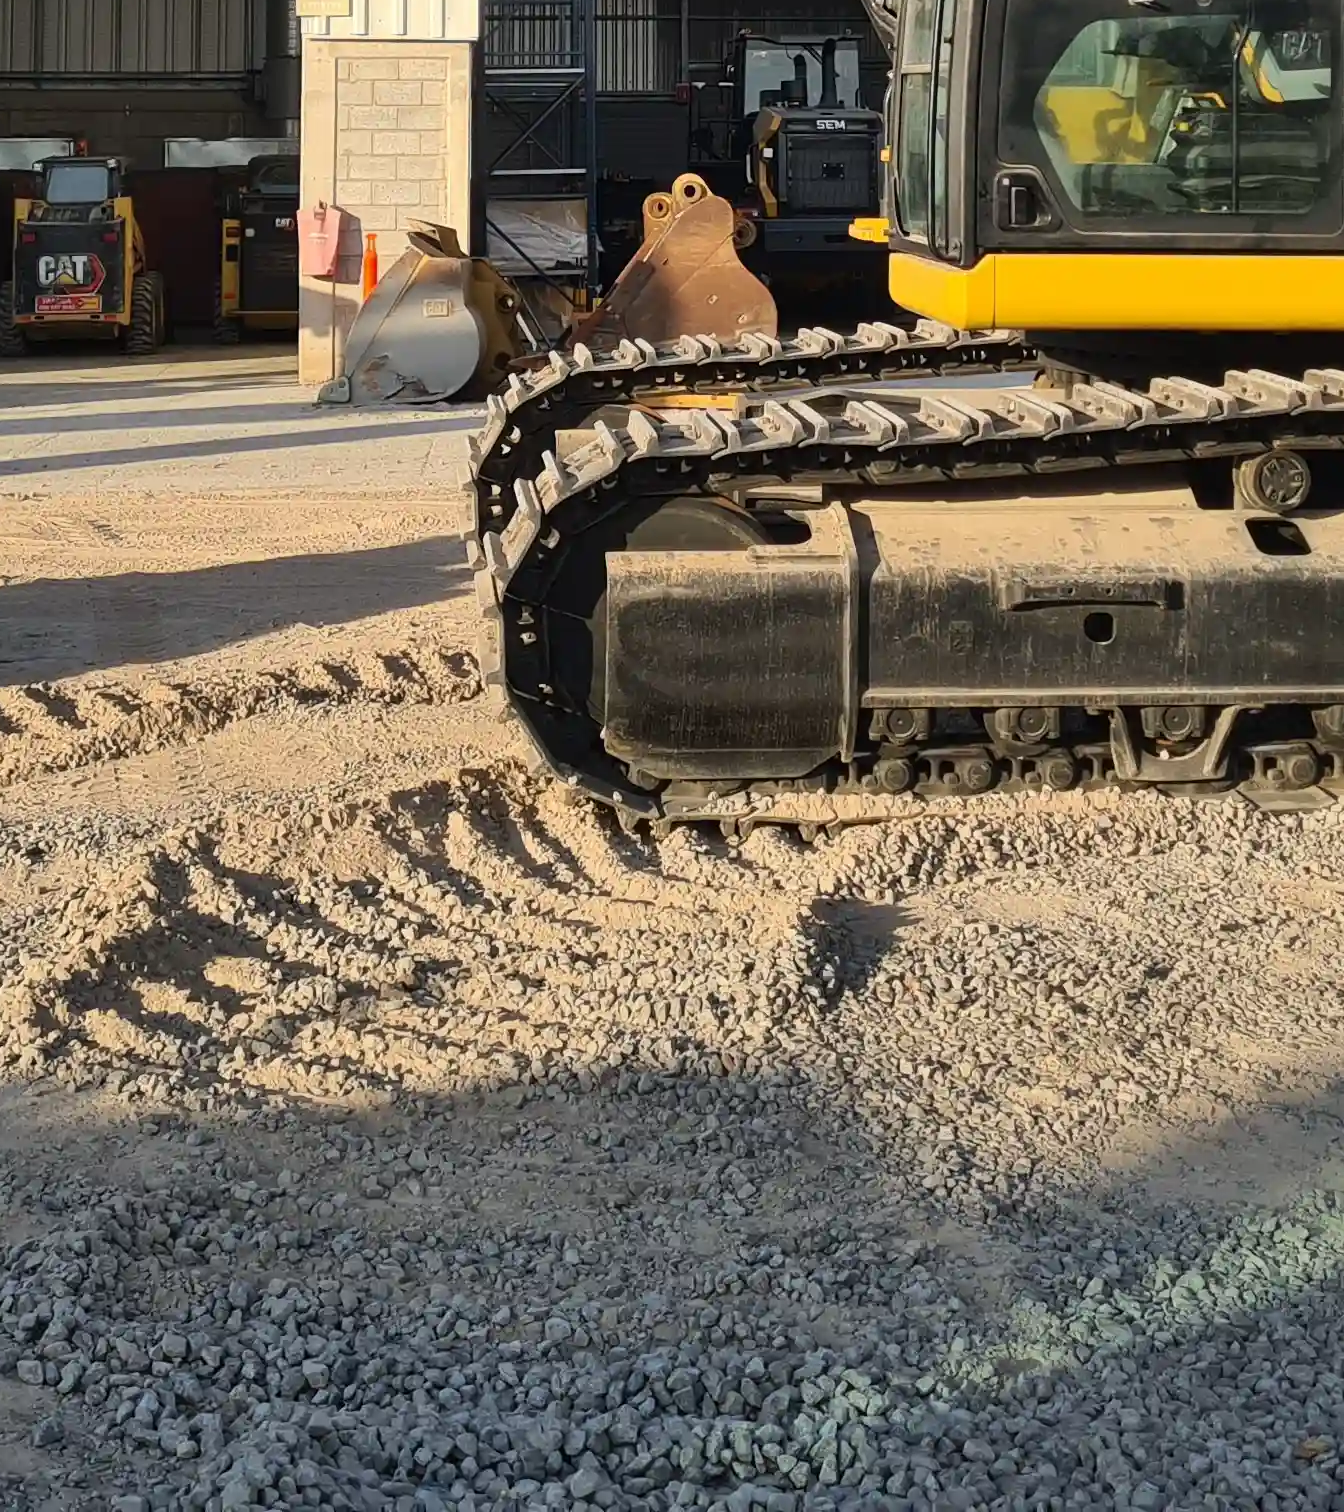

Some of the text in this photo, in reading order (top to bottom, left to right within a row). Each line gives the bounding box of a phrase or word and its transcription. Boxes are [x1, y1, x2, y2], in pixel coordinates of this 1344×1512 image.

[816, 119, 846, 130] SEM
[275, 217, 291, 228] CAT
[38, 255, 88, 286] CAT
